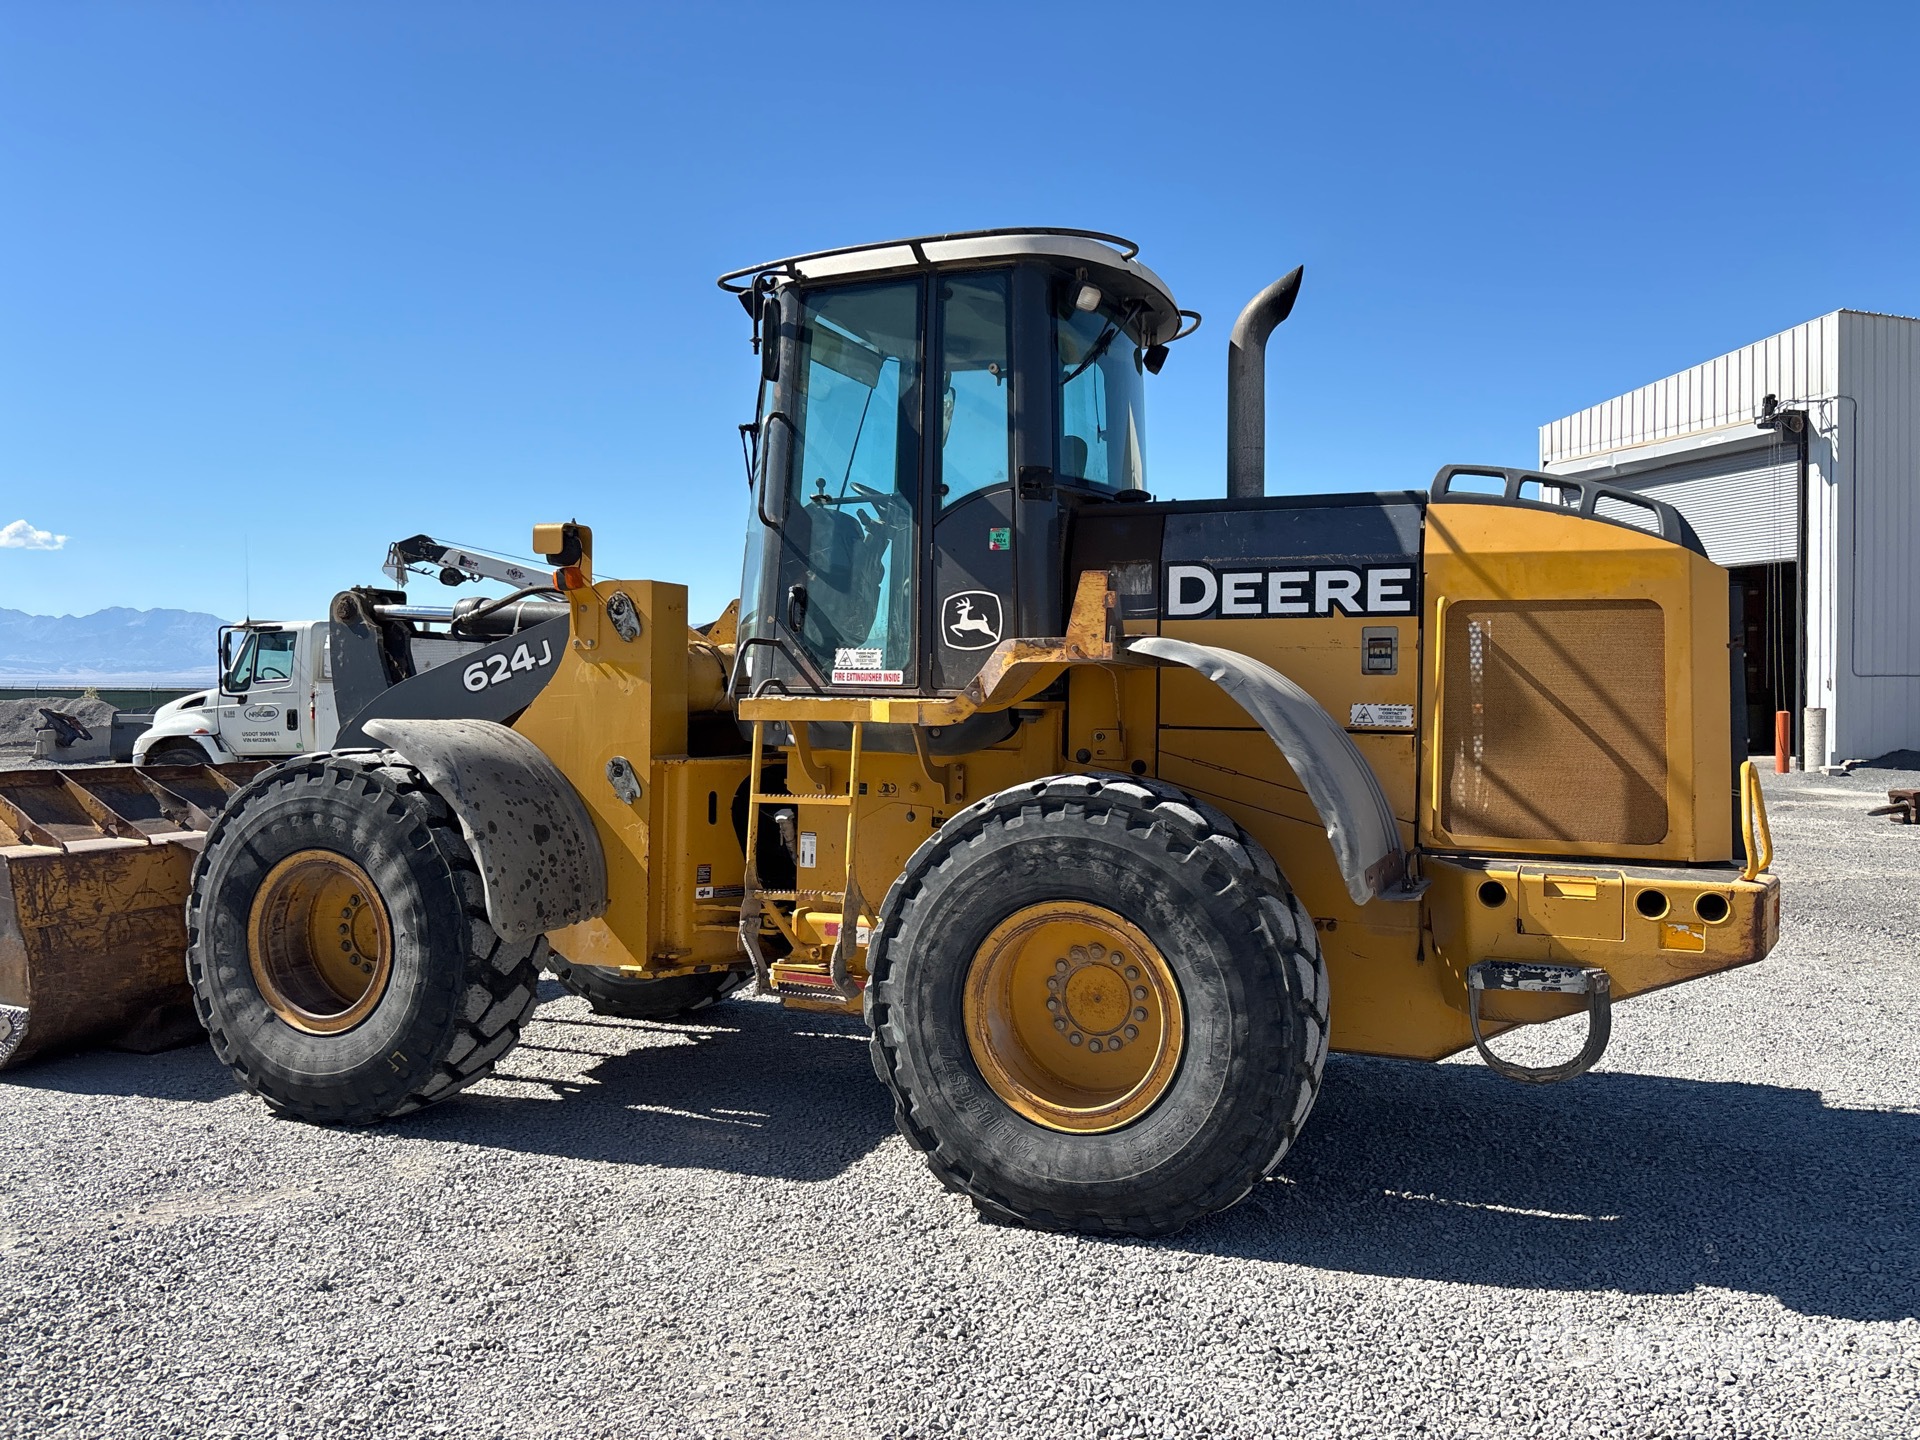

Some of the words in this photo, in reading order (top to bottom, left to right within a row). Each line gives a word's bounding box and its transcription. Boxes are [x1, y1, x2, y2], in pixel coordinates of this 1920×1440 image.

[1168, 565, 1411, 616] DEERE
[463, 639, 552, 692] 624J
[834, 672, 845, 682] FIRE
[846, 672, 882, 682] EXTINGUISHER
[883, 672, 901, 683] INSIDE
